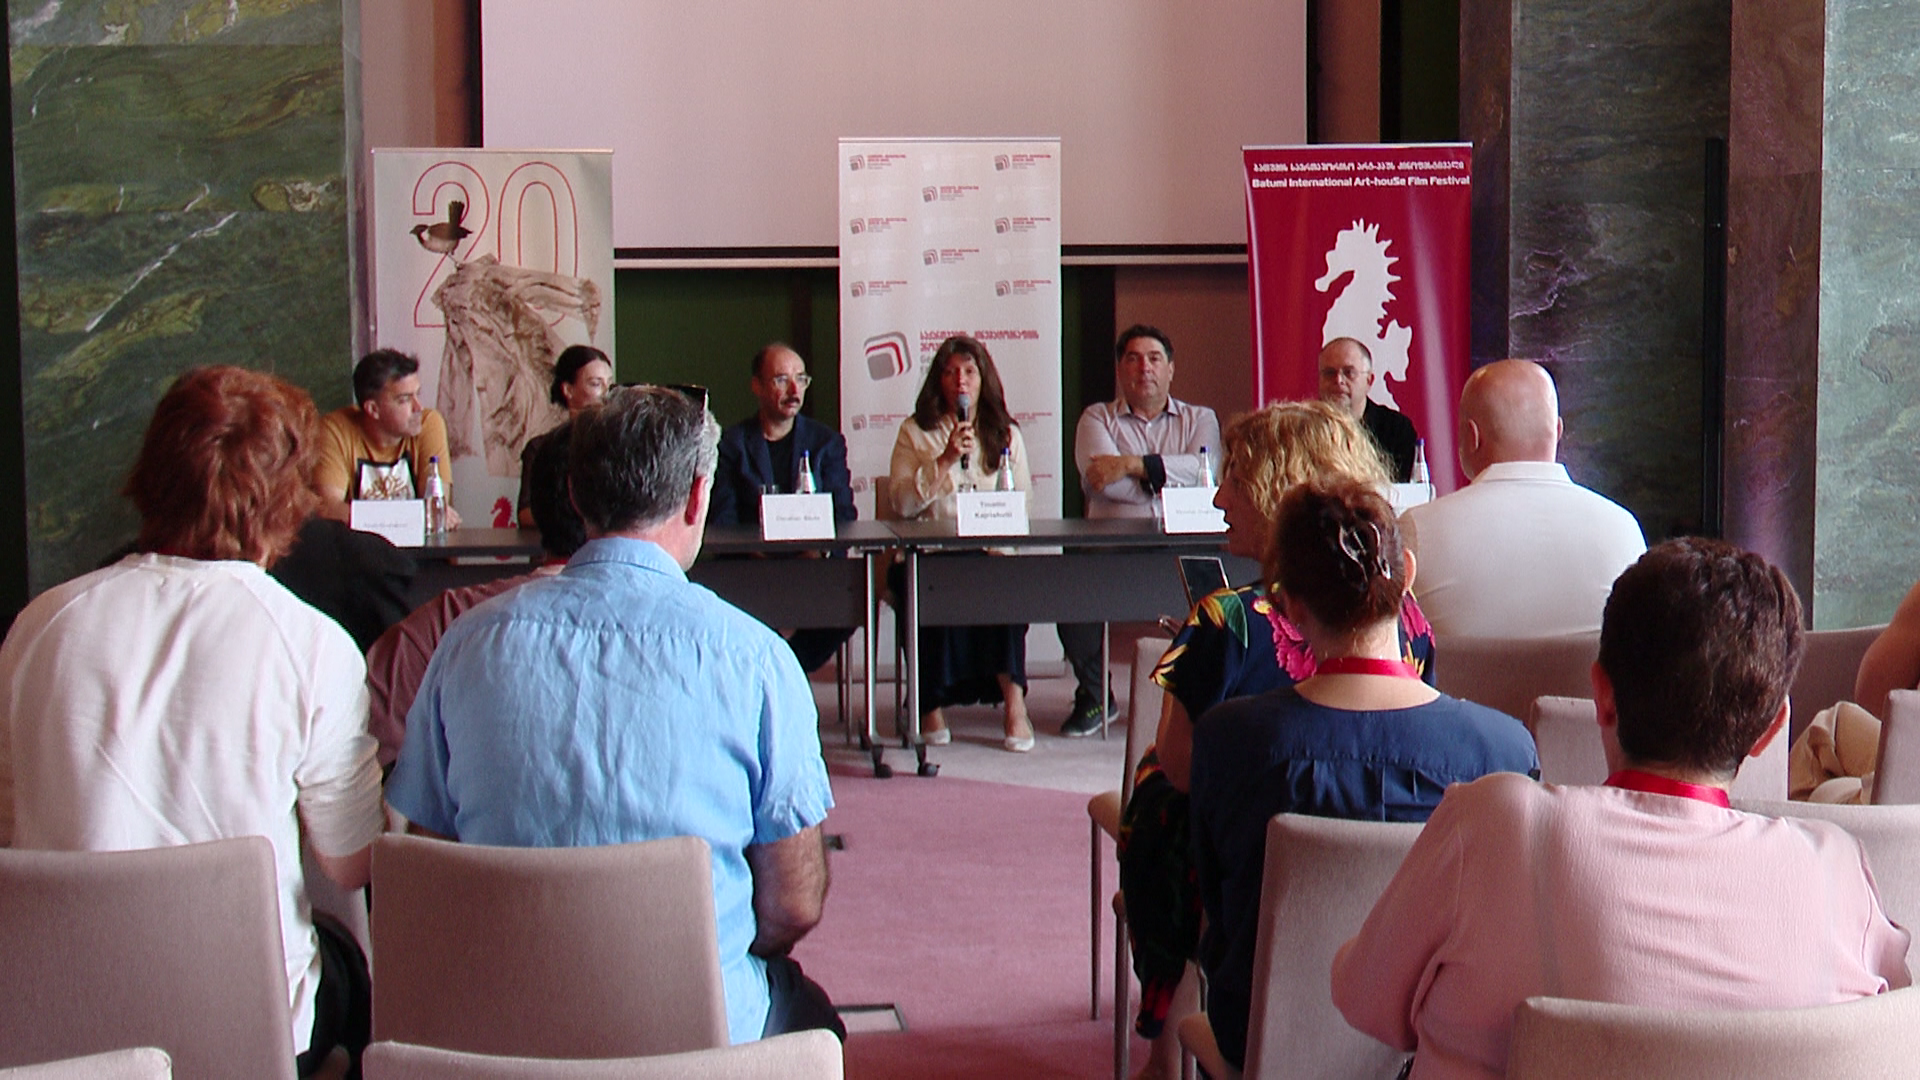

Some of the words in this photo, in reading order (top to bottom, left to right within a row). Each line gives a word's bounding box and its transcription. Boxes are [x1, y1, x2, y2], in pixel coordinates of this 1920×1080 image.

[1252, 178, 1287, 188] Batumi
[1289, 176, 1352, 187] International
[1408, 176, 1428, 186] Film
[1430, 175, 1470, 185] Festival
